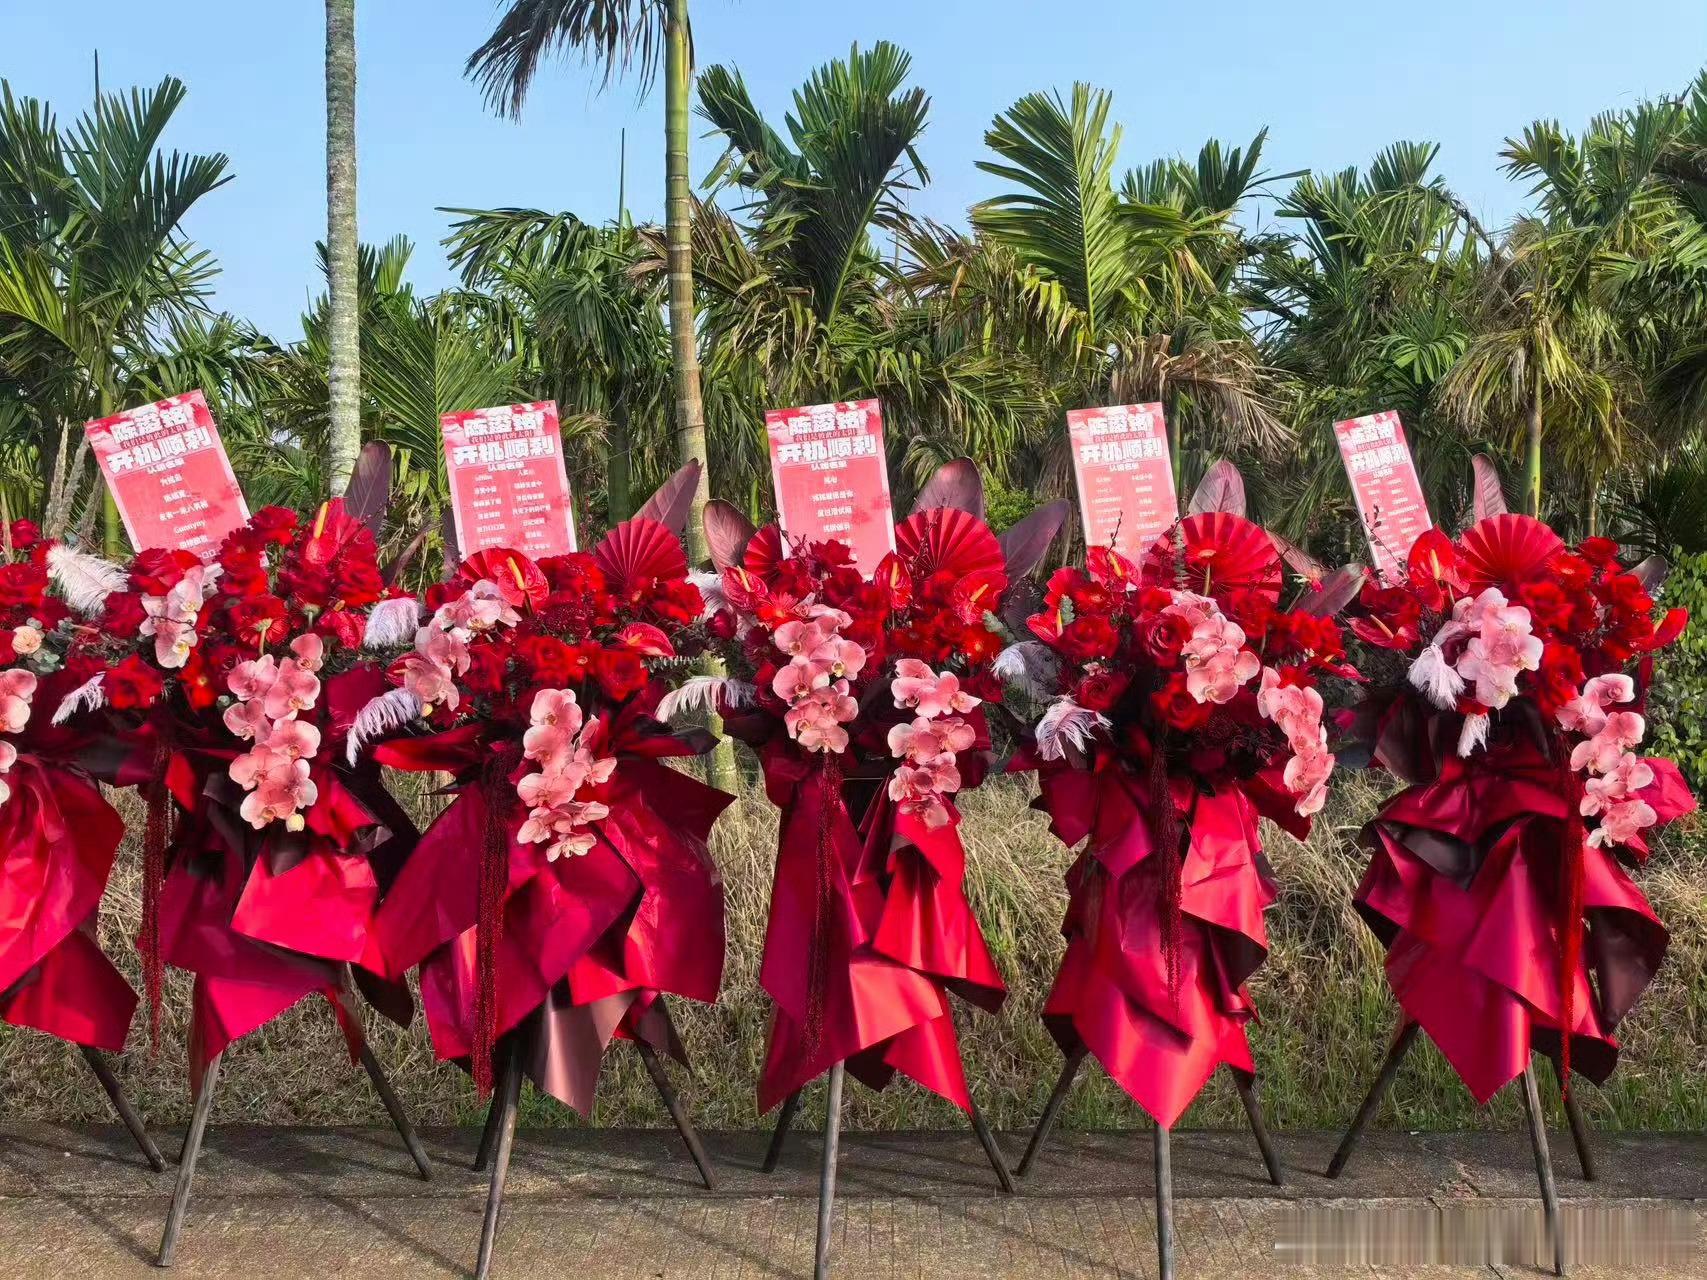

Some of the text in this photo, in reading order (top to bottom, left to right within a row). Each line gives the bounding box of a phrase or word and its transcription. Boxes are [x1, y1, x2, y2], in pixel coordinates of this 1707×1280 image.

[105, 426, 213, 473] 开机顺利
[453, 436, 554, 464] 开机顺利
[777, 435, 876, 463] 开机顺利
[1080, 437, 1162, 464] 开机顺利
